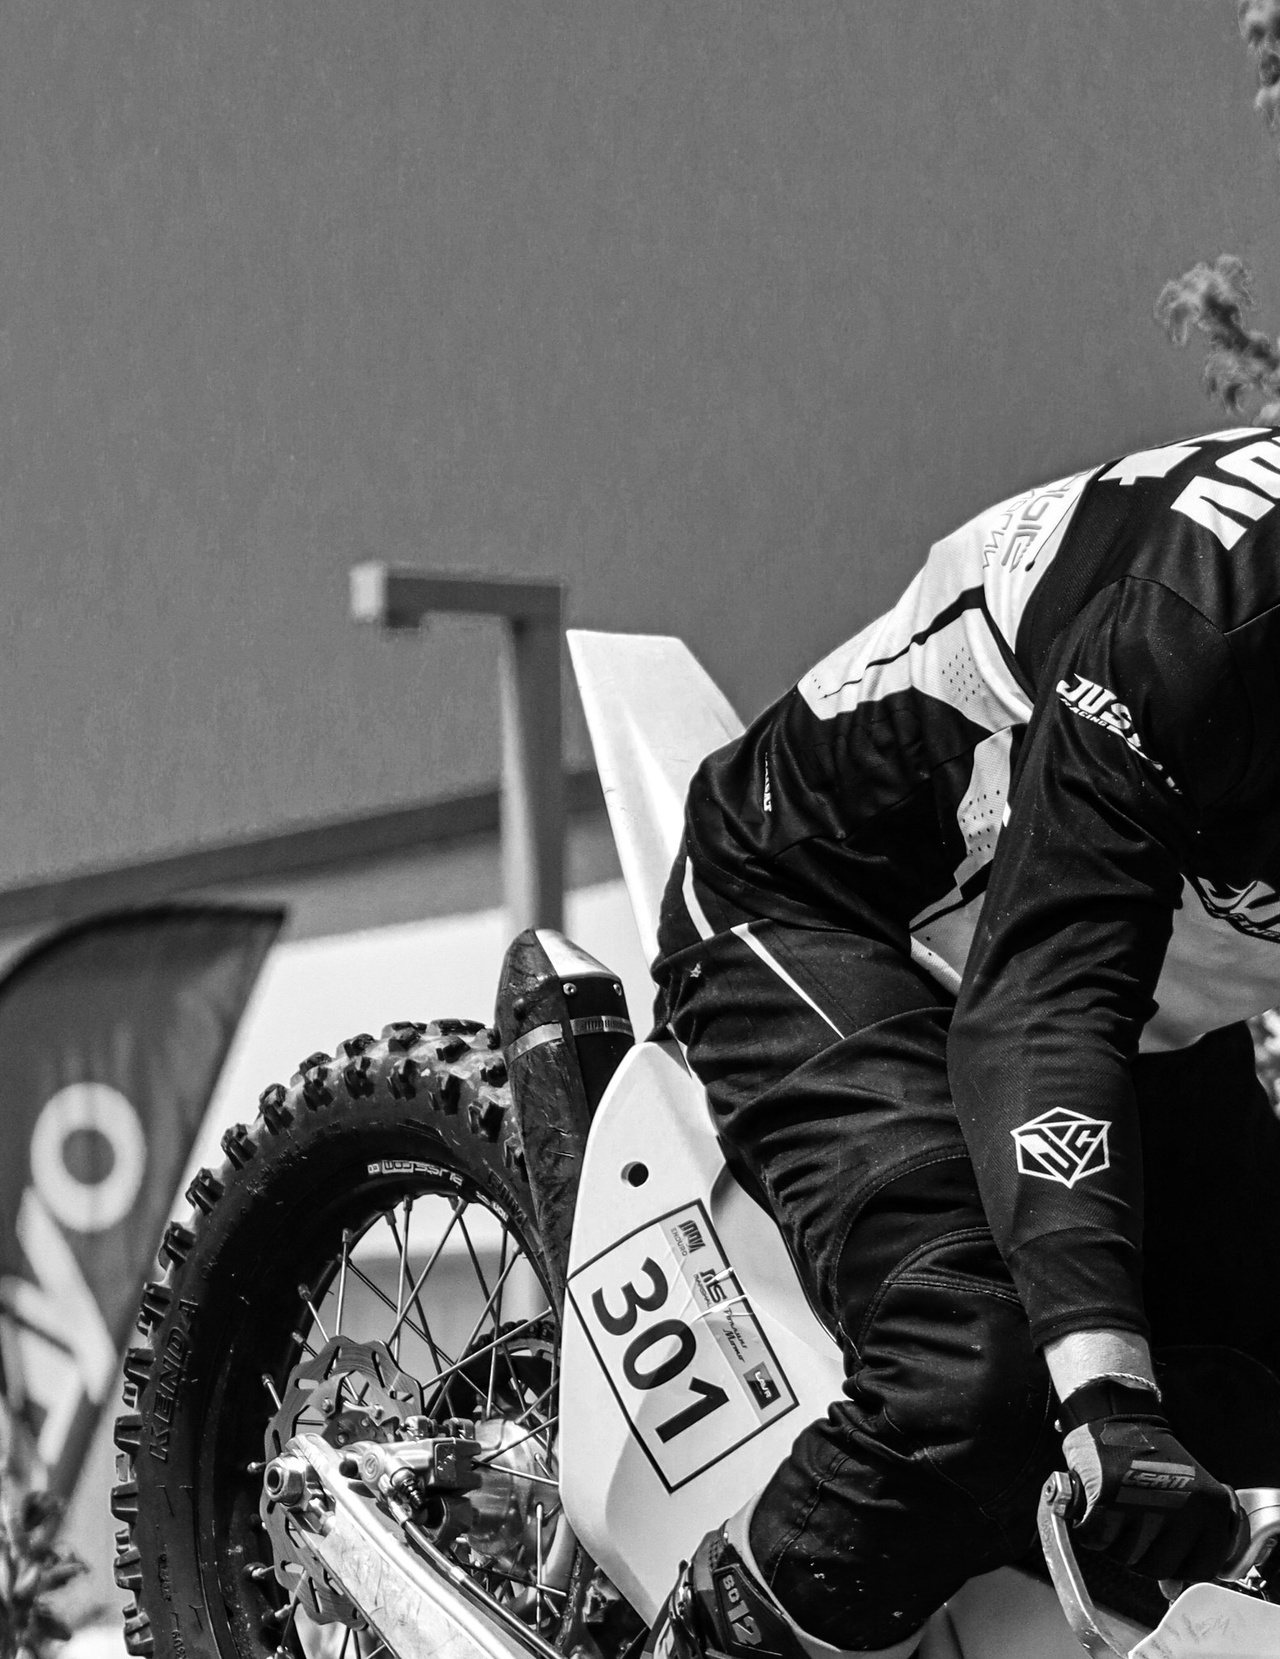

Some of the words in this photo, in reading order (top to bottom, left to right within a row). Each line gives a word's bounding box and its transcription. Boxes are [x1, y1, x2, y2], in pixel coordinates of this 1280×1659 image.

[149, 1298, 199, 1461] KENDA
[590, 1256, 730, 1444] 301
[1121, 1470, 1196, 1490] LEATT
